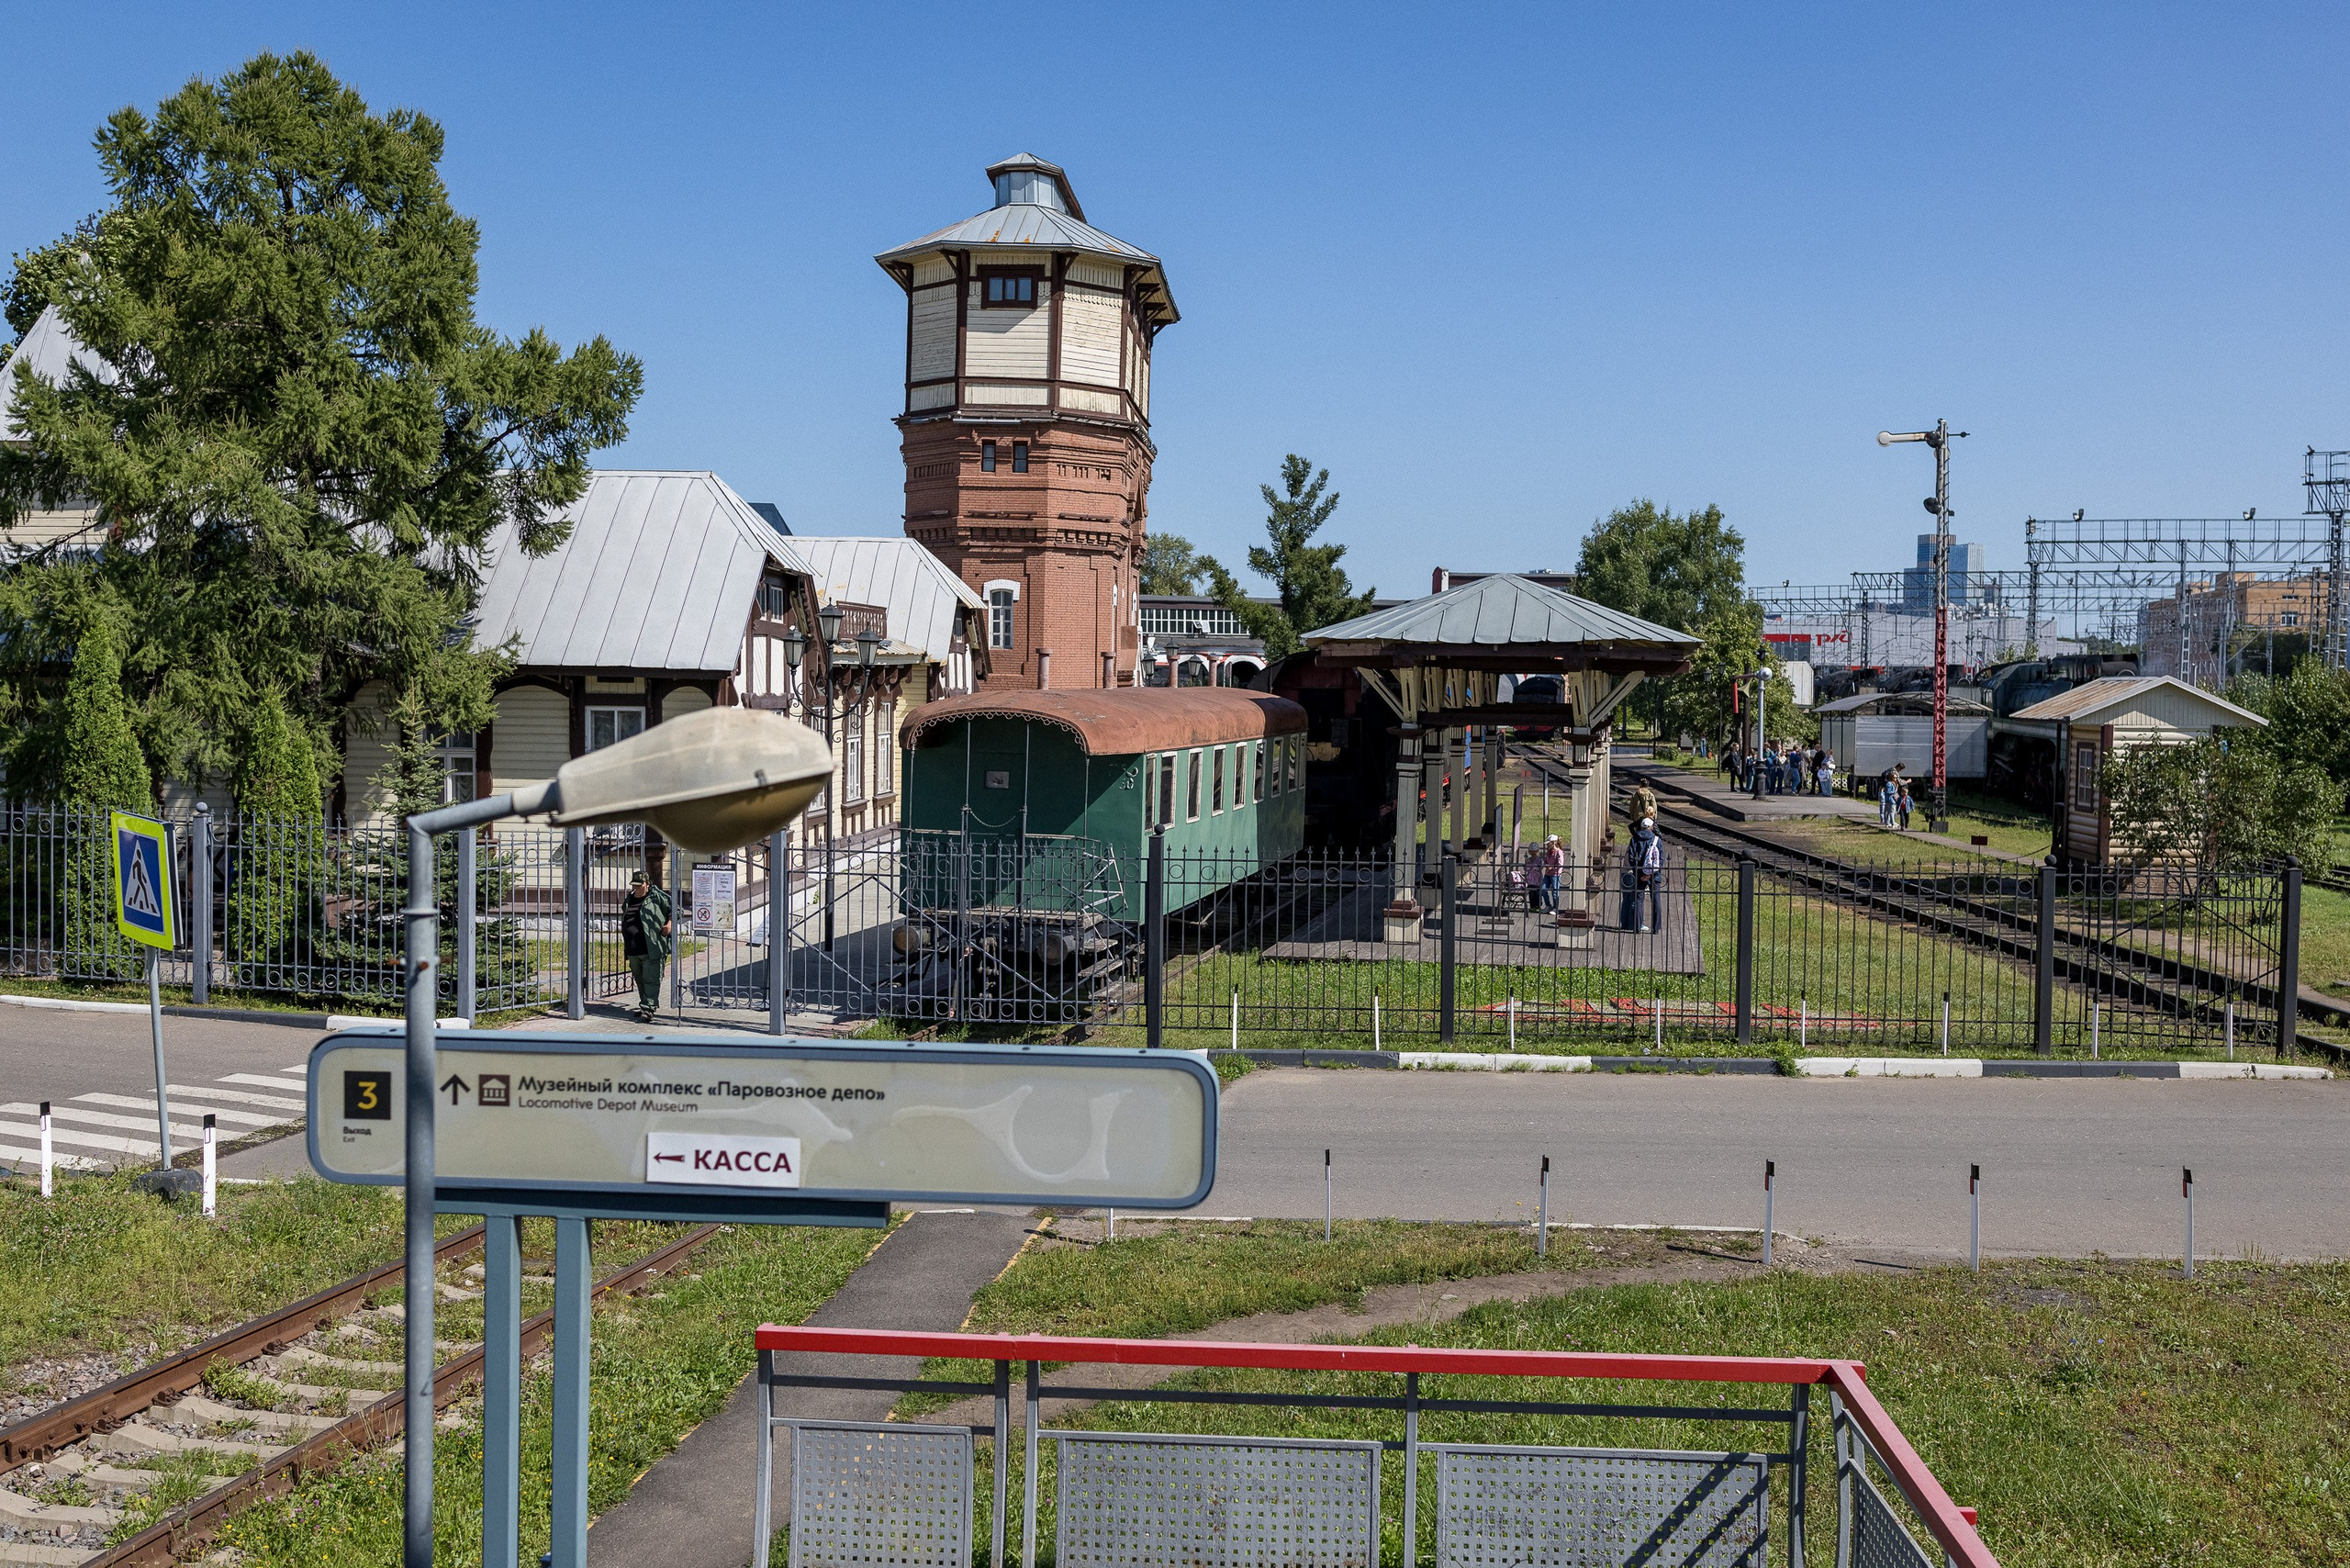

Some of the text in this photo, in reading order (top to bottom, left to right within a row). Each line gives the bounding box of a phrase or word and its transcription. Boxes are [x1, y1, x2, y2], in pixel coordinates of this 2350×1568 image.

[357, 1081, 378, 1110] 3
[518, 1076, 886, 1102] Музейный комплекс «Паровозное депо»
[518, 1096, 699, 1113] Locomotive Depot Museum
[343, 1126, 372, 1136] Выход
[694, 1149, 792, 1173] КАССА
